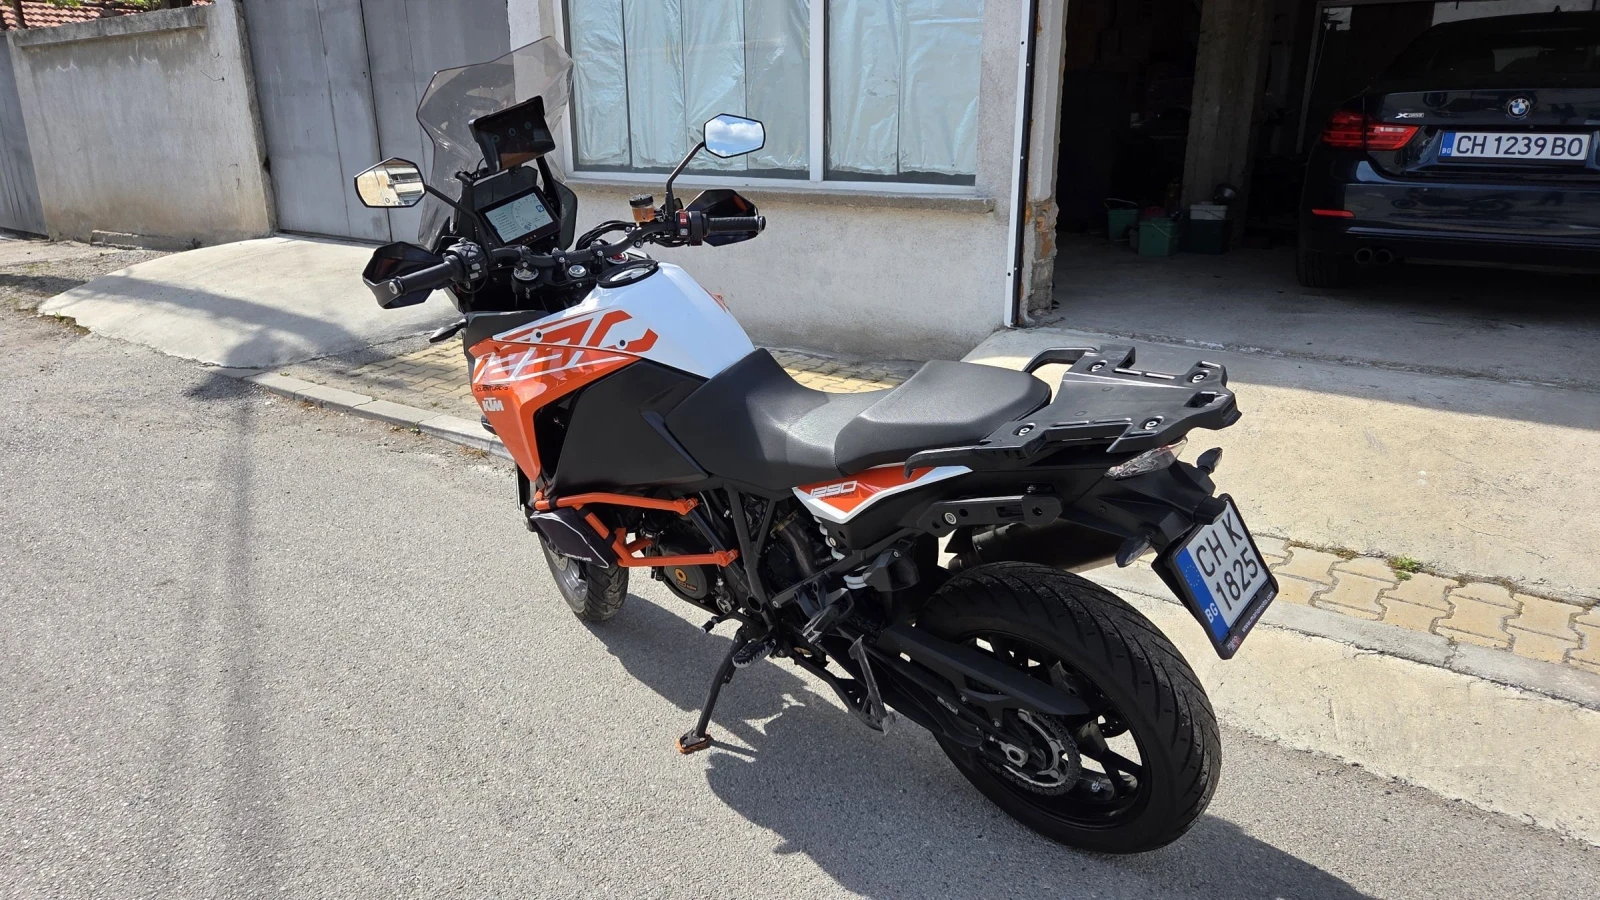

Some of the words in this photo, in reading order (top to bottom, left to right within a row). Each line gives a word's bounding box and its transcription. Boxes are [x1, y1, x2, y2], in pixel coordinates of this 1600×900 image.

[1456, 135, 1488, 155] CH
[1494, 136, 1548, 156] 1239
[1550, 137, 1583, 157] BO
[481, 397, 505, 412] KTM
[810, 480, 858, 498] 1290
[1196, 530, 1228, 577] CH
[1222, 512, 1243, 548] K
[1216, 547, 1258, 611] 1825
[1204, 602, 1219, 624] BG
